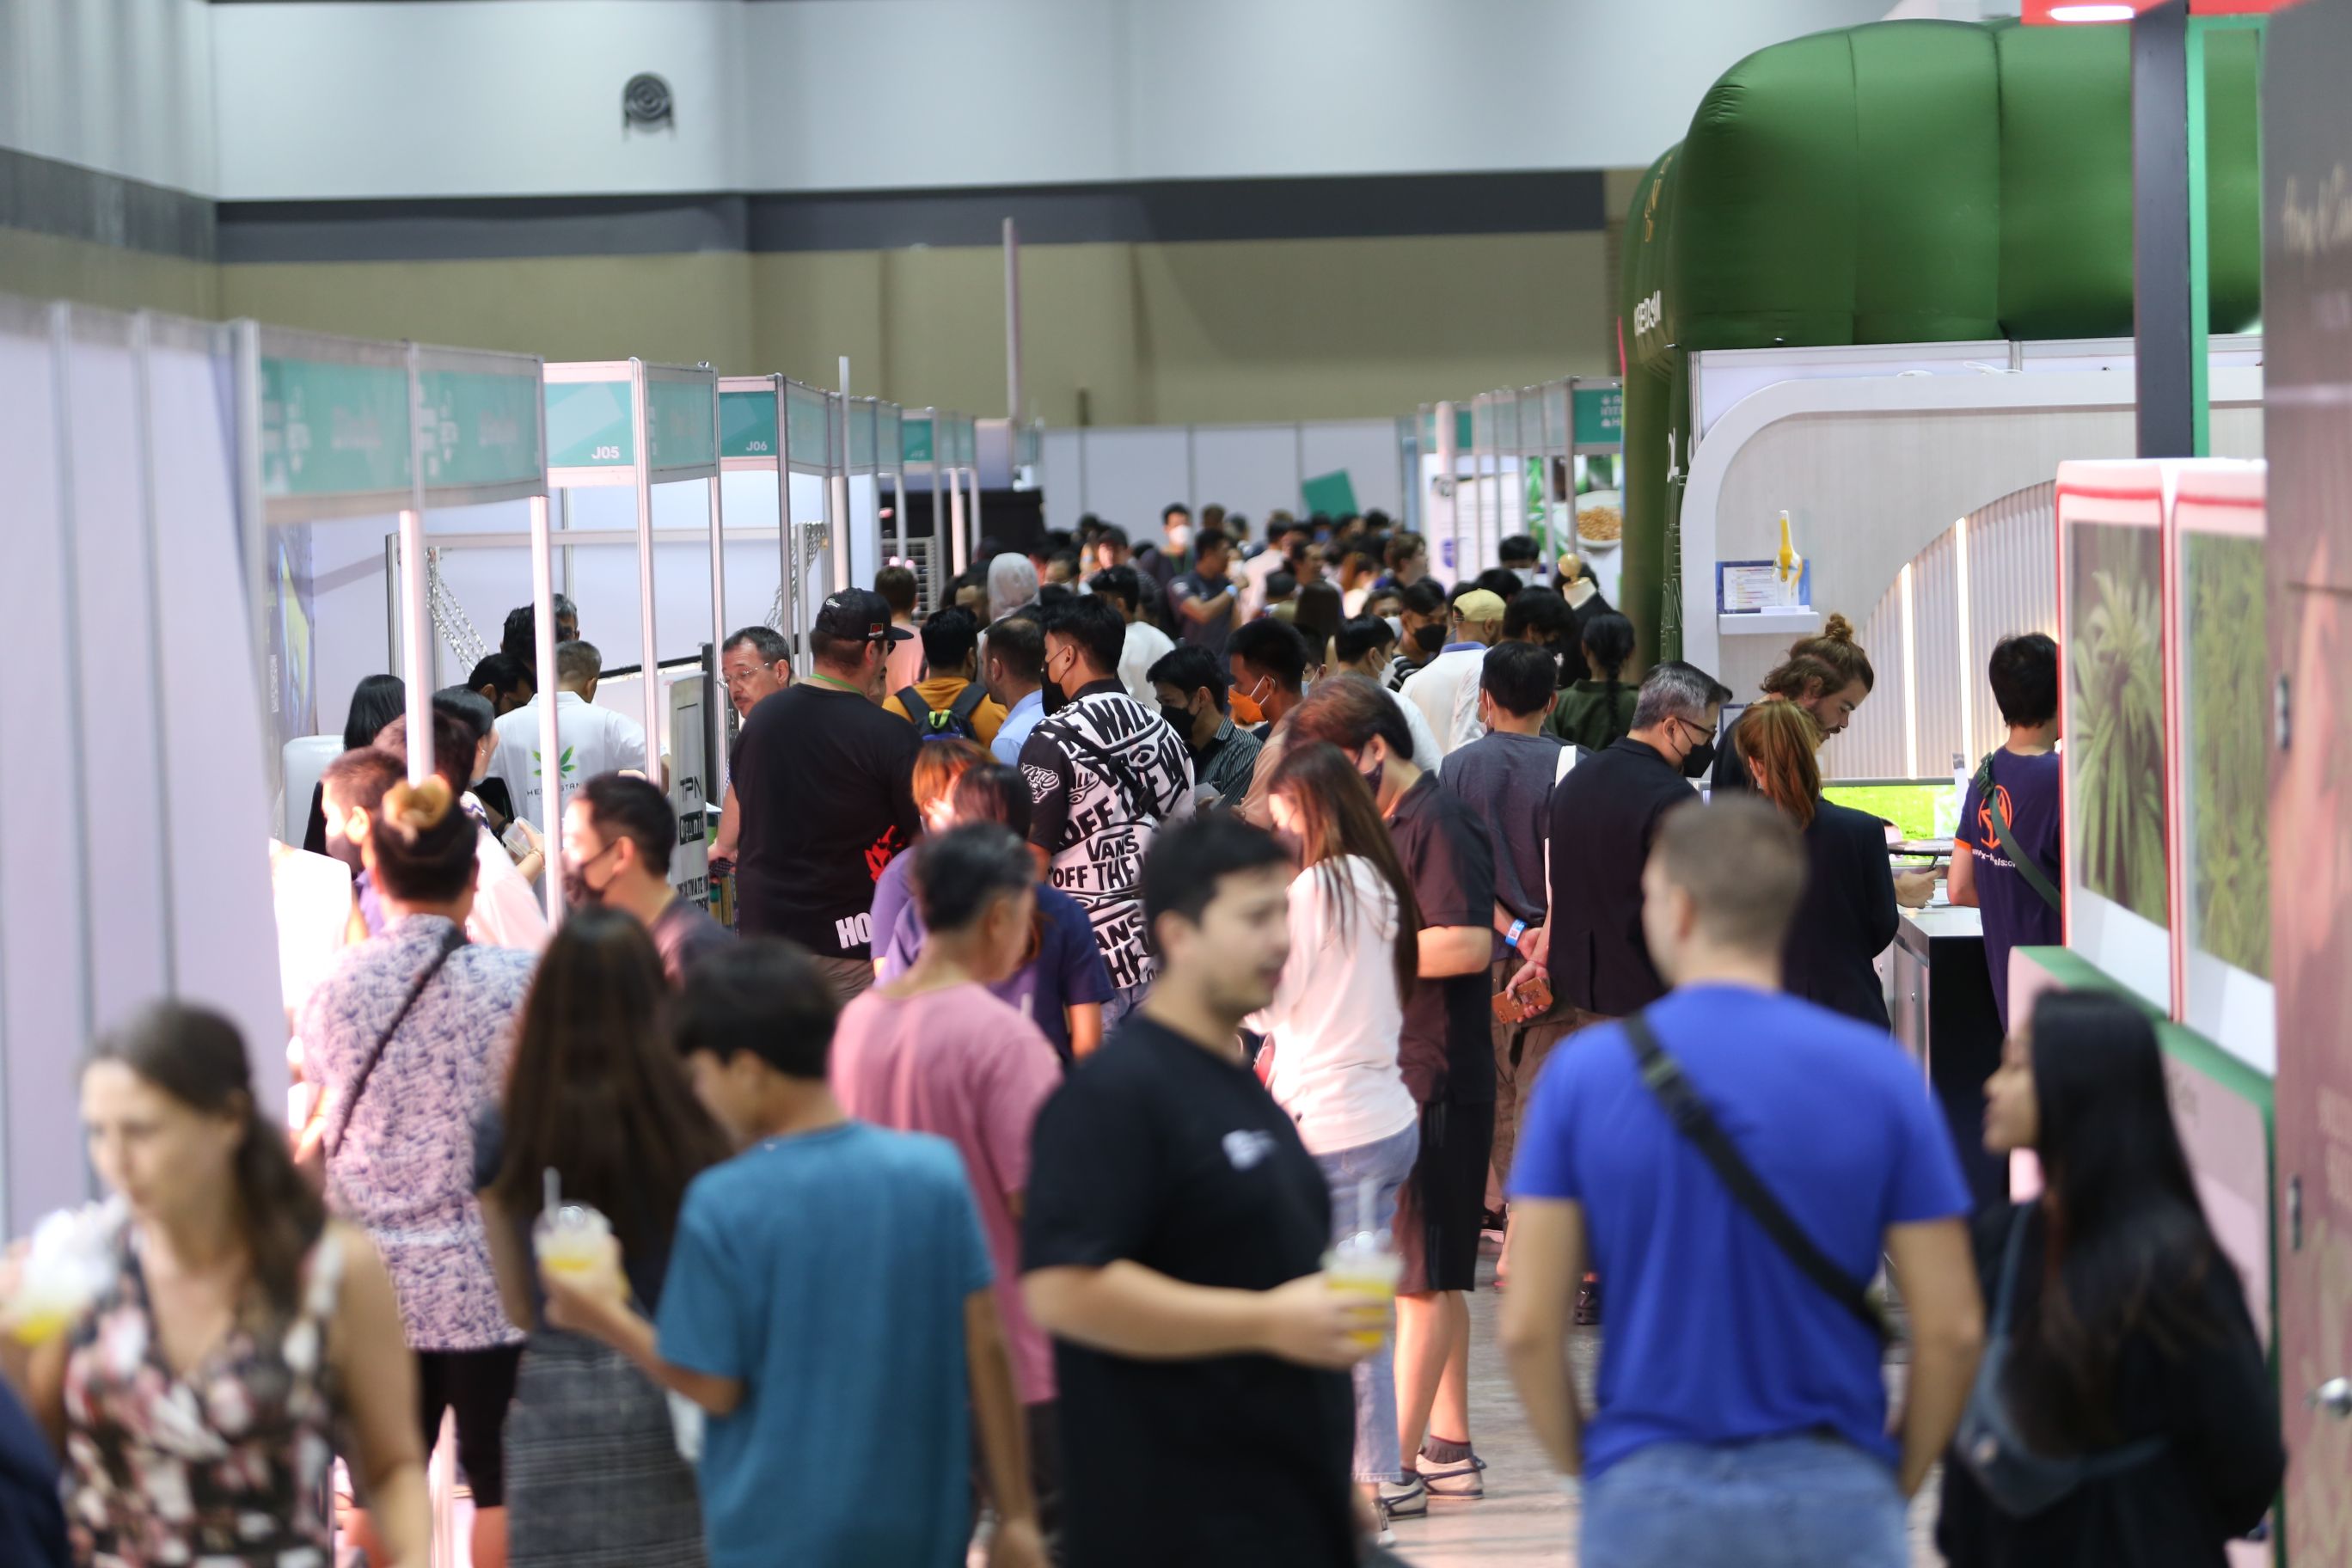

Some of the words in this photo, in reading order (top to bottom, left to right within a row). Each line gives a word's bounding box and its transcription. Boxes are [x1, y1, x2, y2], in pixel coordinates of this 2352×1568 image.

[591, 445, 620, 459] J05
[745, 440, 768, 451] J06
[1086, 828, 1140, 862] VANS
[1093, 857, 1135, 891] THE
[836, 912, 873, 949] HO
[1091, 908, 1148, 951] ANS
[1101, 940, 1141, 988] HE
